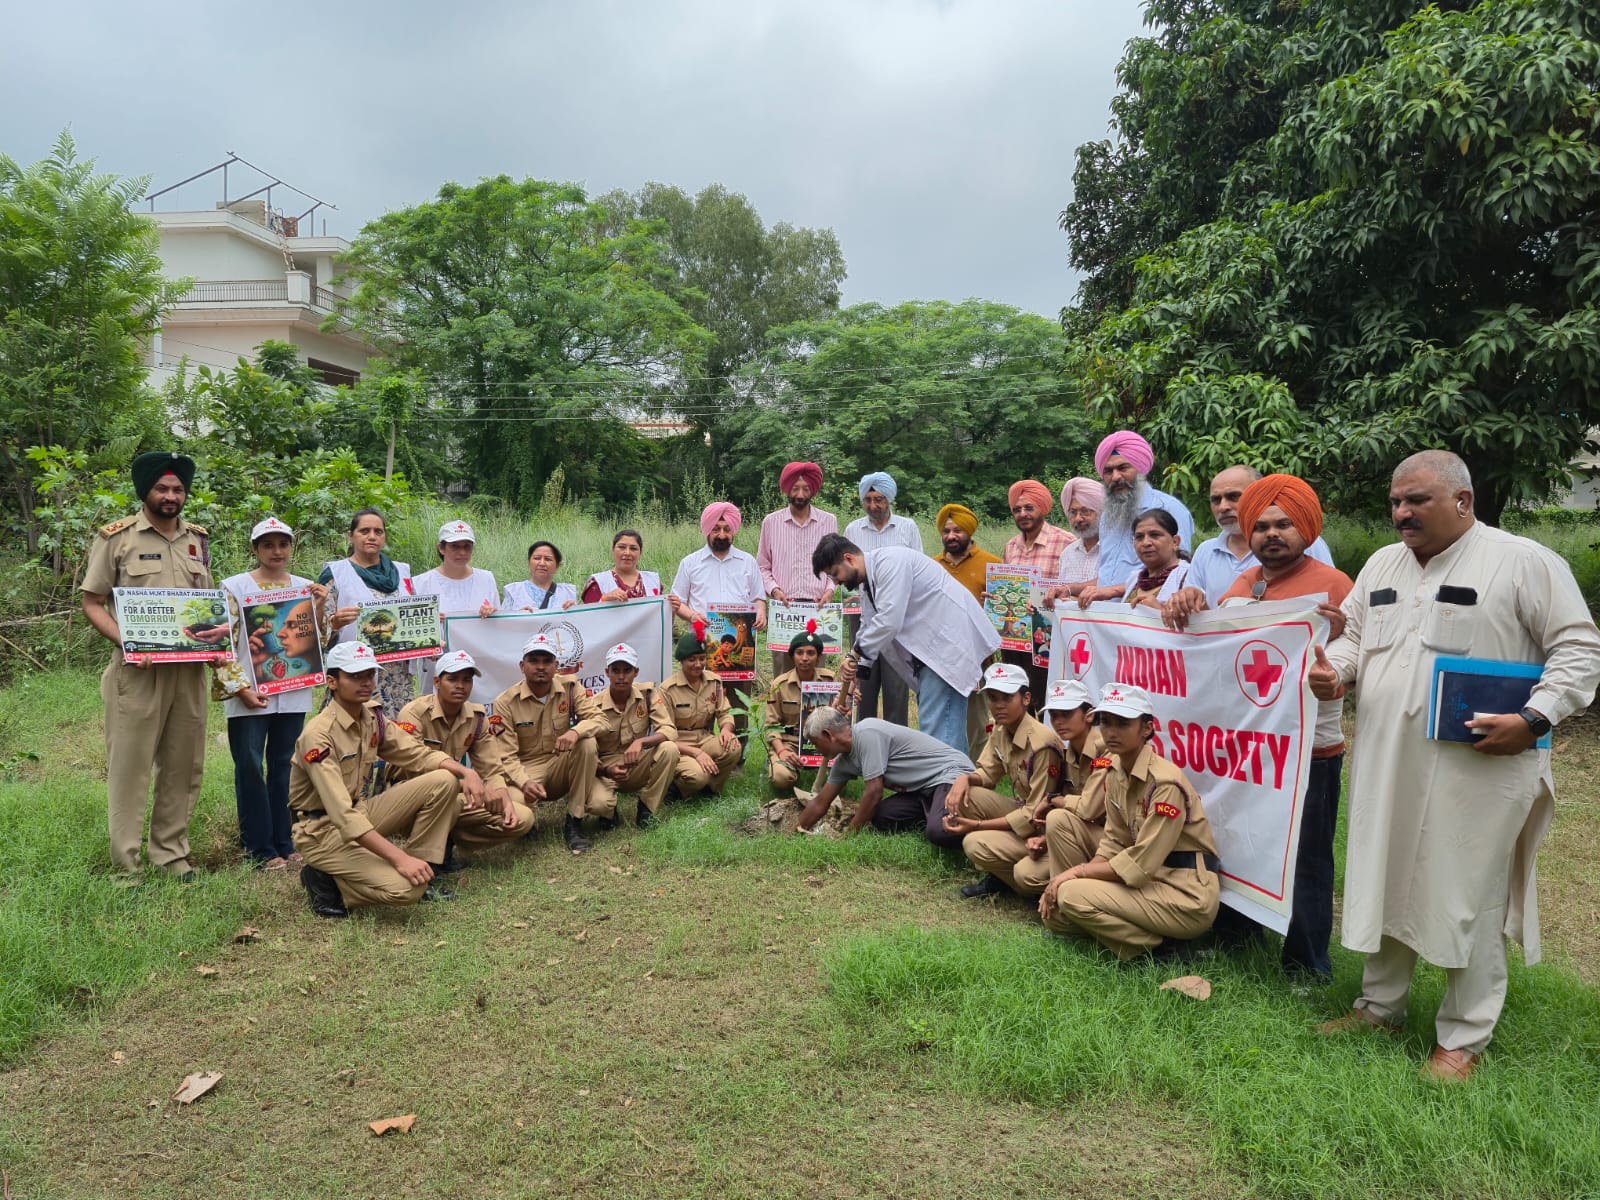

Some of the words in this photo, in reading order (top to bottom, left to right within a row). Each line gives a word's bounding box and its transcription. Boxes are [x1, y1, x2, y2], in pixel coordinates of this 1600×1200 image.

[123, 606, 138, 615] FOR
[140, 606, 146, 615] A
[147, 606, 175, 615] BETTER
[296, 612, 308, 620] NO
[399, 607, 435, 619] PLANT
[124, 614, 177, 623] TOMORROW
[401, 615, 435, 627] TREES
[775, 612, 806, 623] PLANT
[776, 621, 806, 631] TREES
[1114, 644, 1187, 698] INDIAN
[1168, 719, 1291, 790] SOCIETY
[1095, 759, 1109, 767] NCC
[1157, 804, 1176, 816] NCC
